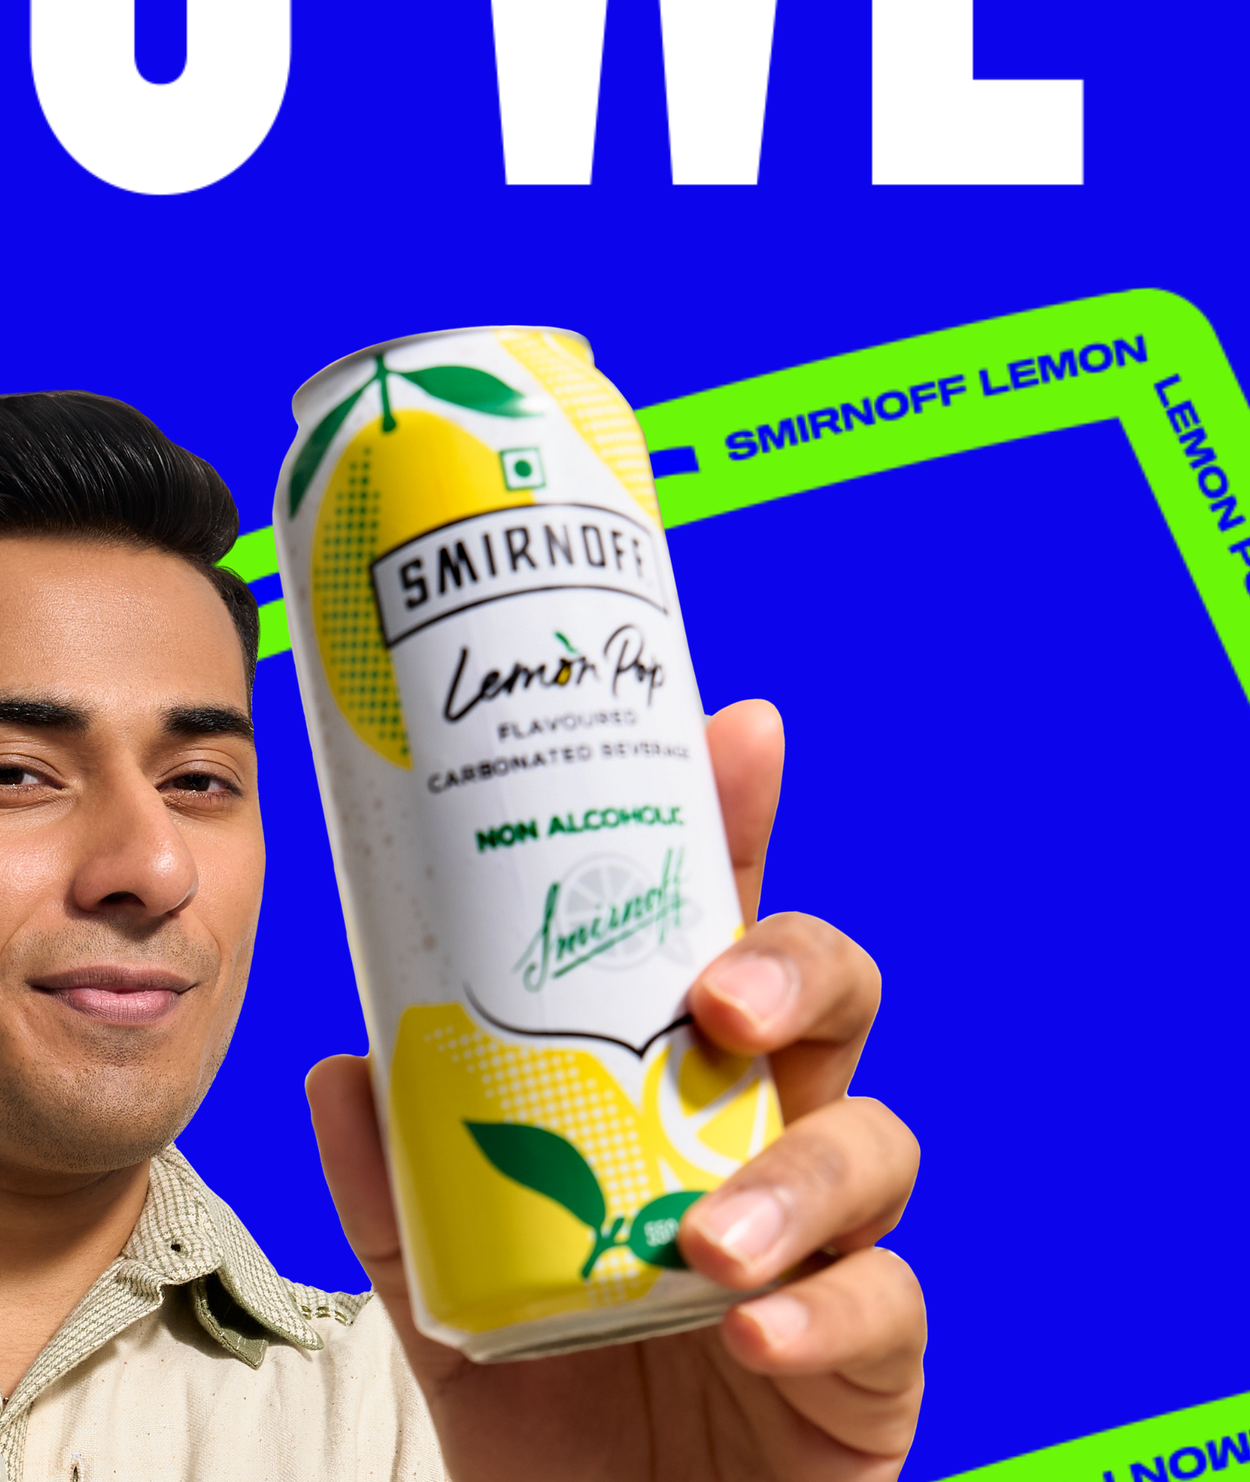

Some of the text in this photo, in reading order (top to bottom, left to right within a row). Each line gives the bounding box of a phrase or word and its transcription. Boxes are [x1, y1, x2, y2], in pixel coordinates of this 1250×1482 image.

[399, 523, 644, 609] SMIRNOFF
[443, 623, 665, 724] Lemon Pop
[497, 709, 637, 739] FLAVOURED
[427, 745, 592, 794] CARBONATED
[475, 820, 539, 854] NON
[513, 844, 688, 994] Smirnoff
